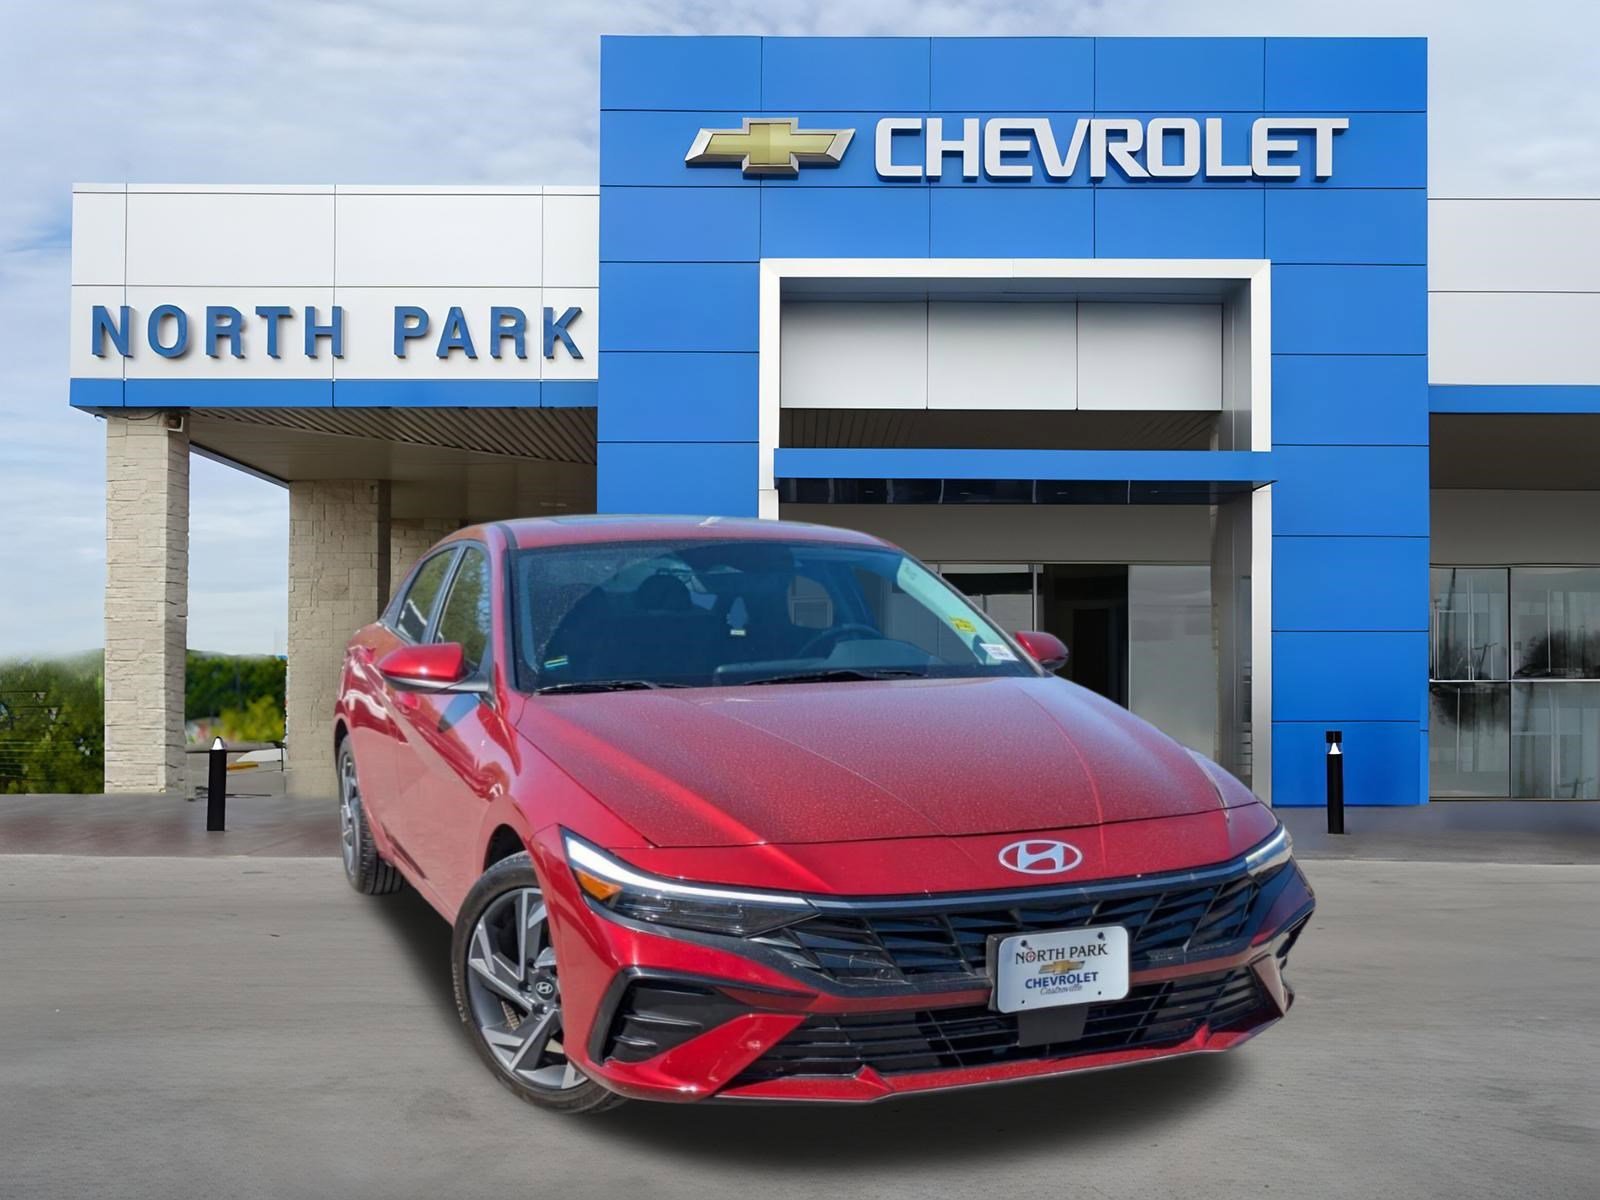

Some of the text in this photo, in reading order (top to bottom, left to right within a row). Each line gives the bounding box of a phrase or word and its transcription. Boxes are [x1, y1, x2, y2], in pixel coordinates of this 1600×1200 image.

[875, 117, 1349, 179] CHEVROLET
[91, 304, 585, 360] NORTH PARK
[1015, 943, 1108, 965] NORTH PARK
[1025, 971, 1099, 989] CHEVROLET
